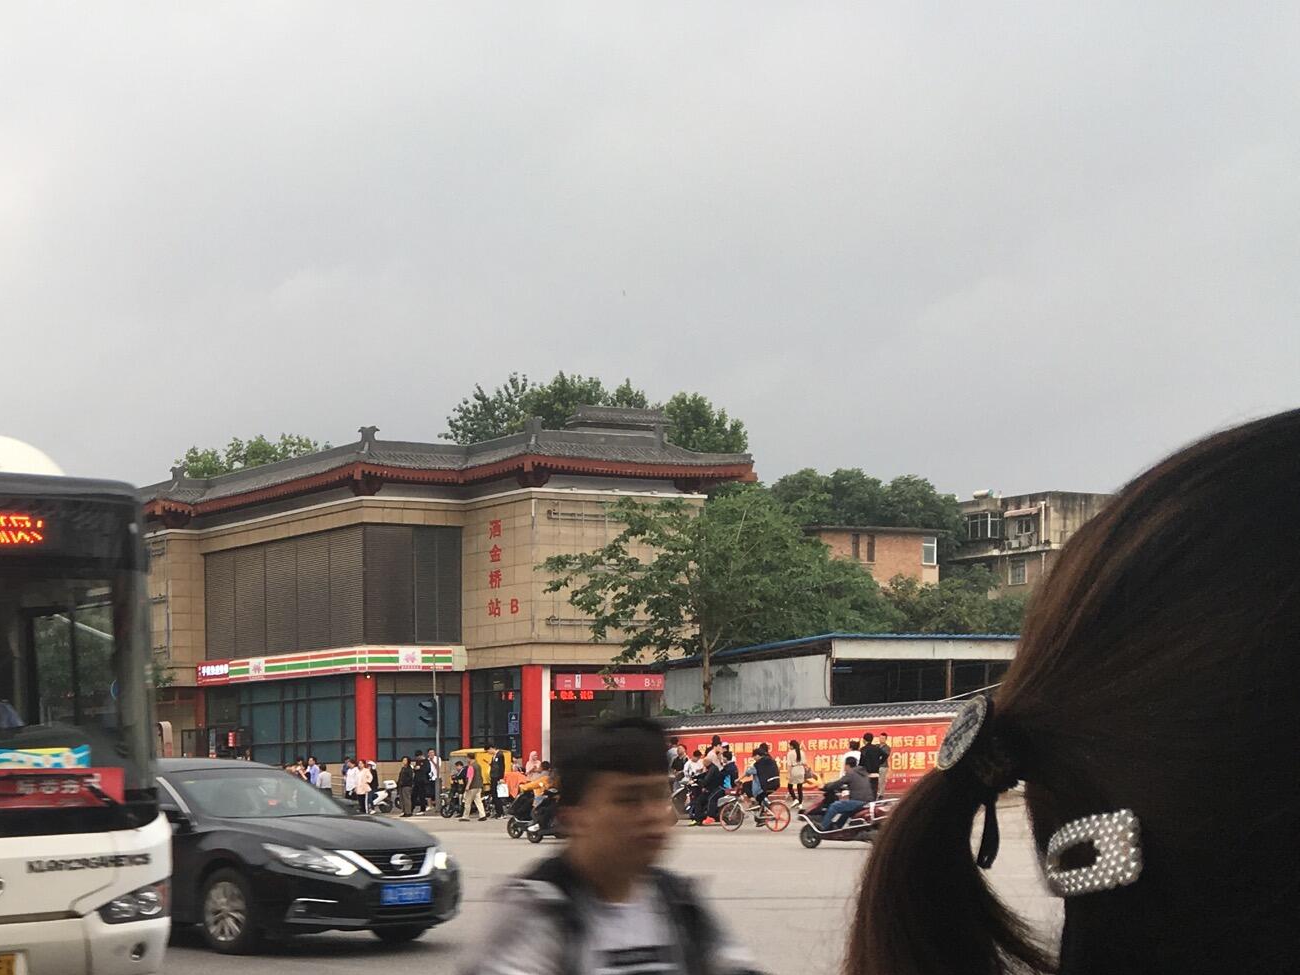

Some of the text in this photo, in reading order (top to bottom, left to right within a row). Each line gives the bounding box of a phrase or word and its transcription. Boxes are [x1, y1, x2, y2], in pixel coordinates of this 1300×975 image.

[488, 520, 502, 617] 洒金桥站
[510, 599, 519, 614] B
